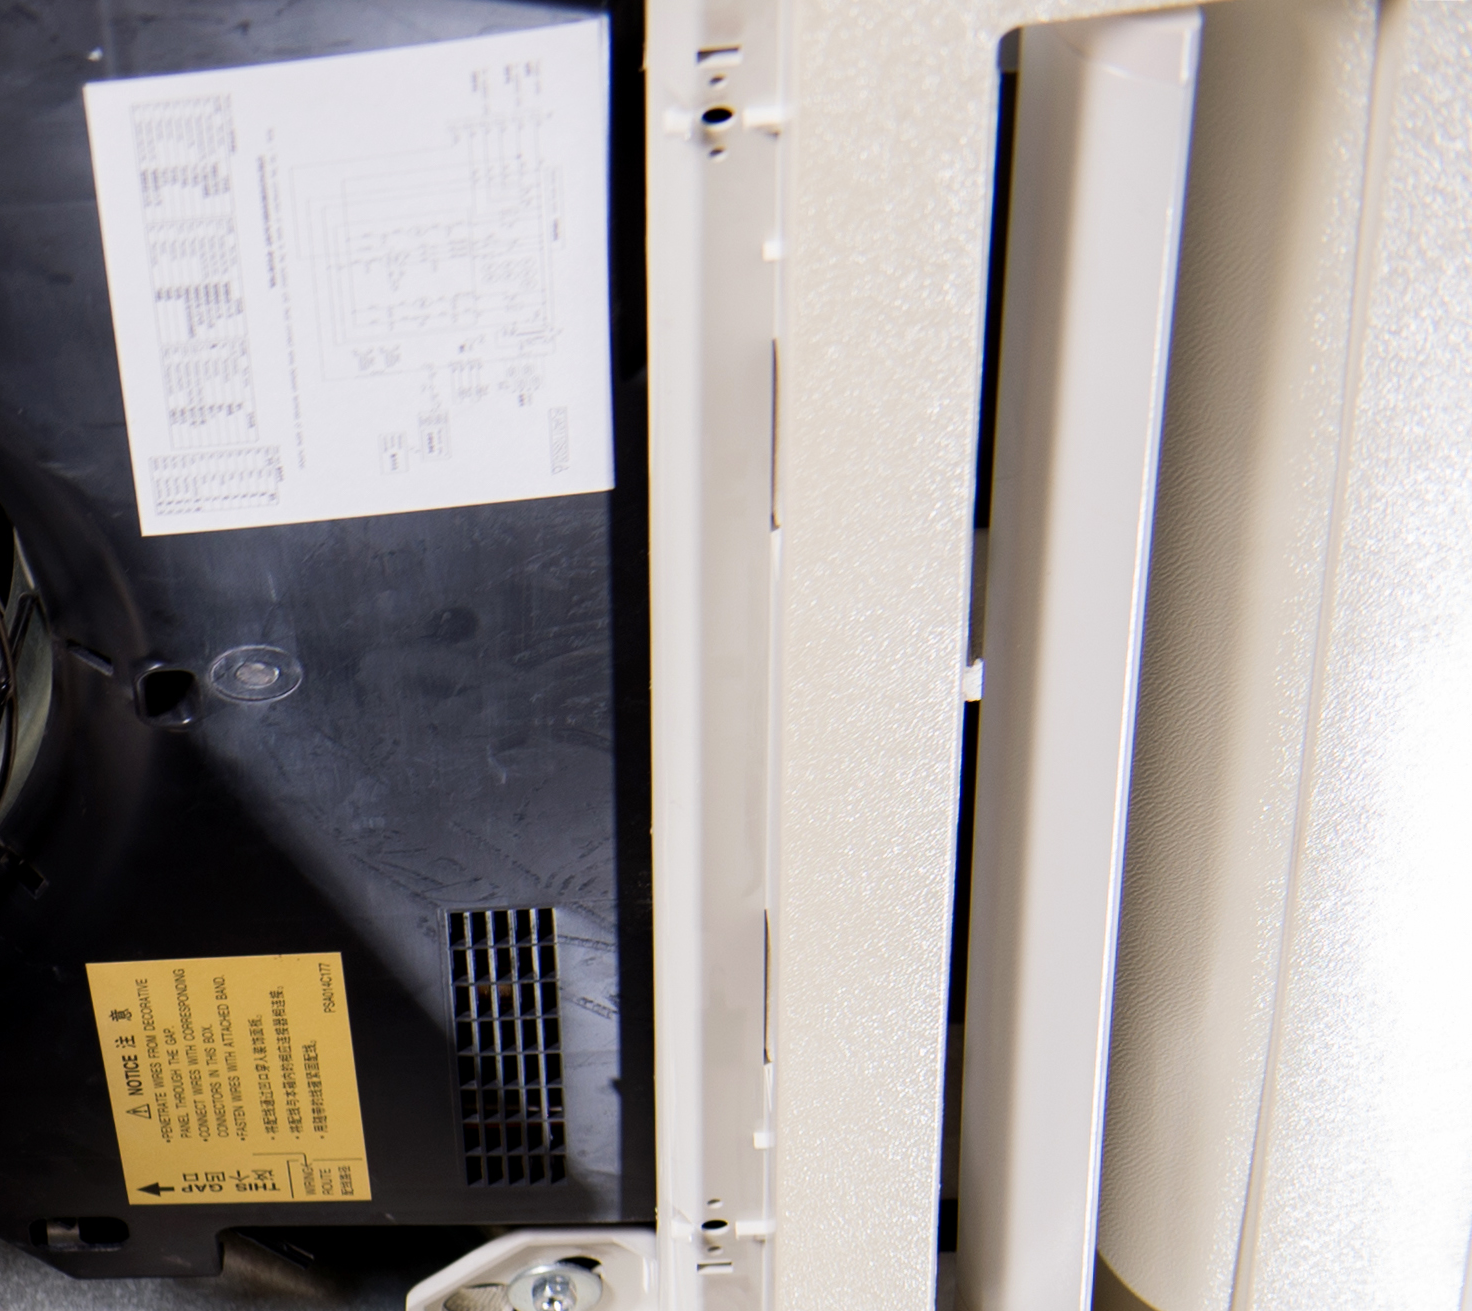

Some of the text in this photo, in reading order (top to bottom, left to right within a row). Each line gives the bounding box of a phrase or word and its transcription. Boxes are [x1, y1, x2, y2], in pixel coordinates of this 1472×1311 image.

[317, 962, 336, 1013] PSA014C177
[216, 1003, 235, 1048] ATTACHED
[134, 978, 173, 1140] PENETRATE WIRES FROM DECORATIVE
[165, 1049, 180, 1066] THE
[172, 968, 211, 1139] CONNECT WIRES WITH CORRESPONDING
[203, 1047, 218, 1067] THIS
[224, 1051, 238, 1073] WITH
[121, 1053, 144, 1097] NOTICE
[208, 1069, 220, 1078] IN
[170, 1069, 186, 1110] THROUGH
[227, 1075, 243, 1103] WIRES
[209, 1081, 230, 1138] CONNECTORS
[232, 1105, 247, 1137] FASTEN
[177, 1112, 191, 1139] PANEL
[181, 1181, 281, 1193] THIS GAP
[301, 1168, 316, 1195] WIRING
[318, 1168, 334, 1195] ROUTE
